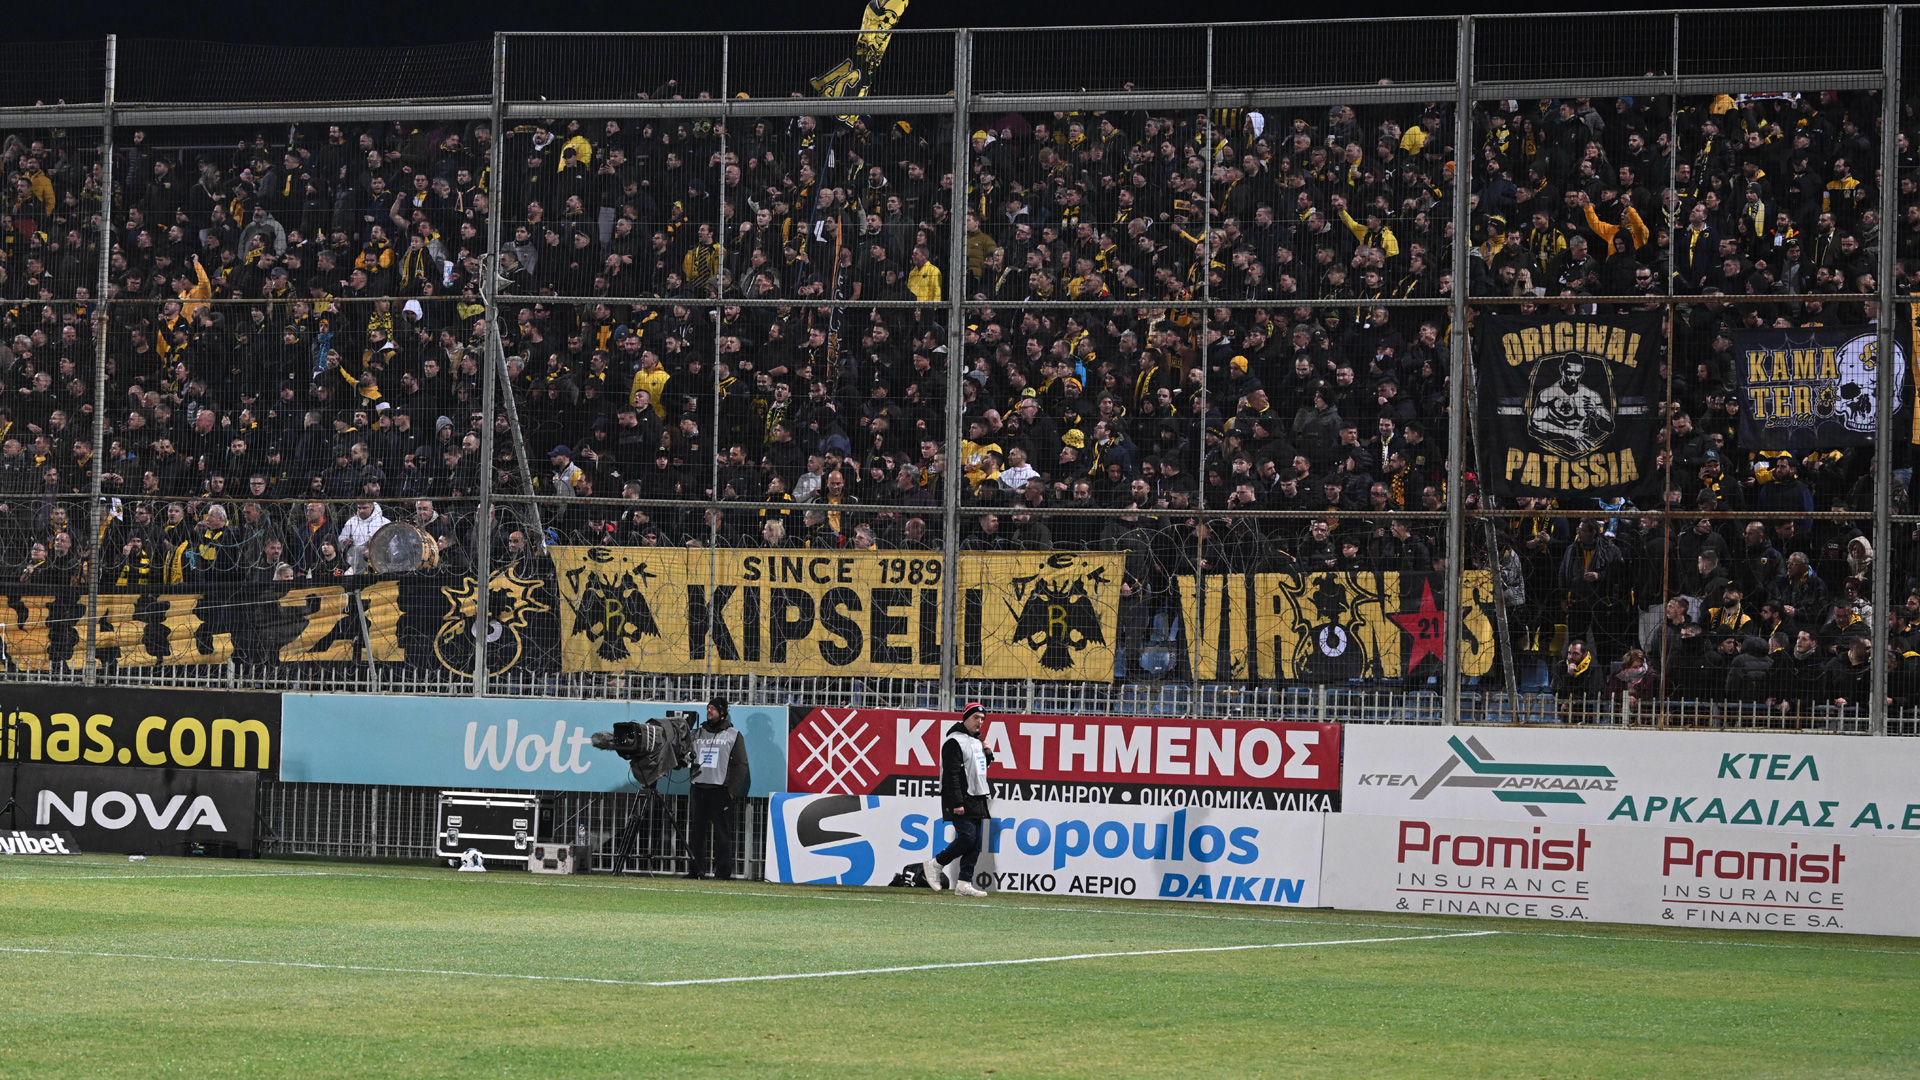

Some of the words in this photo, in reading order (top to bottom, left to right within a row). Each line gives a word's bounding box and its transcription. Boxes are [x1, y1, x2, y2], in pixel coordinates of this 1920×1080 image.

[1502, 321, 1642, 368] ORIGINAL
[1746, 347, 1839, 383] KAMA
[1748, 386, 1815, 420] TER
[1505, 447, 1640, 490] PATISSIA
[743, 556, 854, 585] SINCE
[878, 558, 942, 585] 1989
[279, 580, 405, 662] 21
[687, 584, 983, 666] KIPSELI
[1418, 617, 1439, 639] 21
[0, 712, 270, 769] nas.com
[464, 718, 592, 774] Wolt
[1358, 774, 1418, 786] ΚΤΕΛ
[1501, 777, 1618, 791] ΑΡΚΑΔΙΑΣ
[1717, 753, 1820, 781] ΚΤΕΛ
[36, 790, 227, 832] NOVA
[1607, 795, 1839, 827] ΑΡΚΑΔΙΑΣ
[0, 831, 70, 854] vibet
[899, 808, 1259, 870] spropoulos
[1397, 820, 1592, 872] Promist
[1663, 836, 1846, 884] Promist
[976, 871, 1056, 892] ΦΥΣΙΚΟ
[1068, 875, 1136, 895] ΑΕΡΙΟ
[1159, 873, 1305, 901] DAIKIN
[1397, 872, 1589, 894] INSURANCE
[1663, 885, 1844, 905] INSURANCE
[1396, 897, 1409, 910] &
[1422, 898, 1538, 917] FINANCE
[1550, 905, 1589, 919] S.A.
[1662, 908, 1675, 920] &
[1687, 909, 1796, 926] FINANCE
[1808, 915, 1844, 928] S.A.
